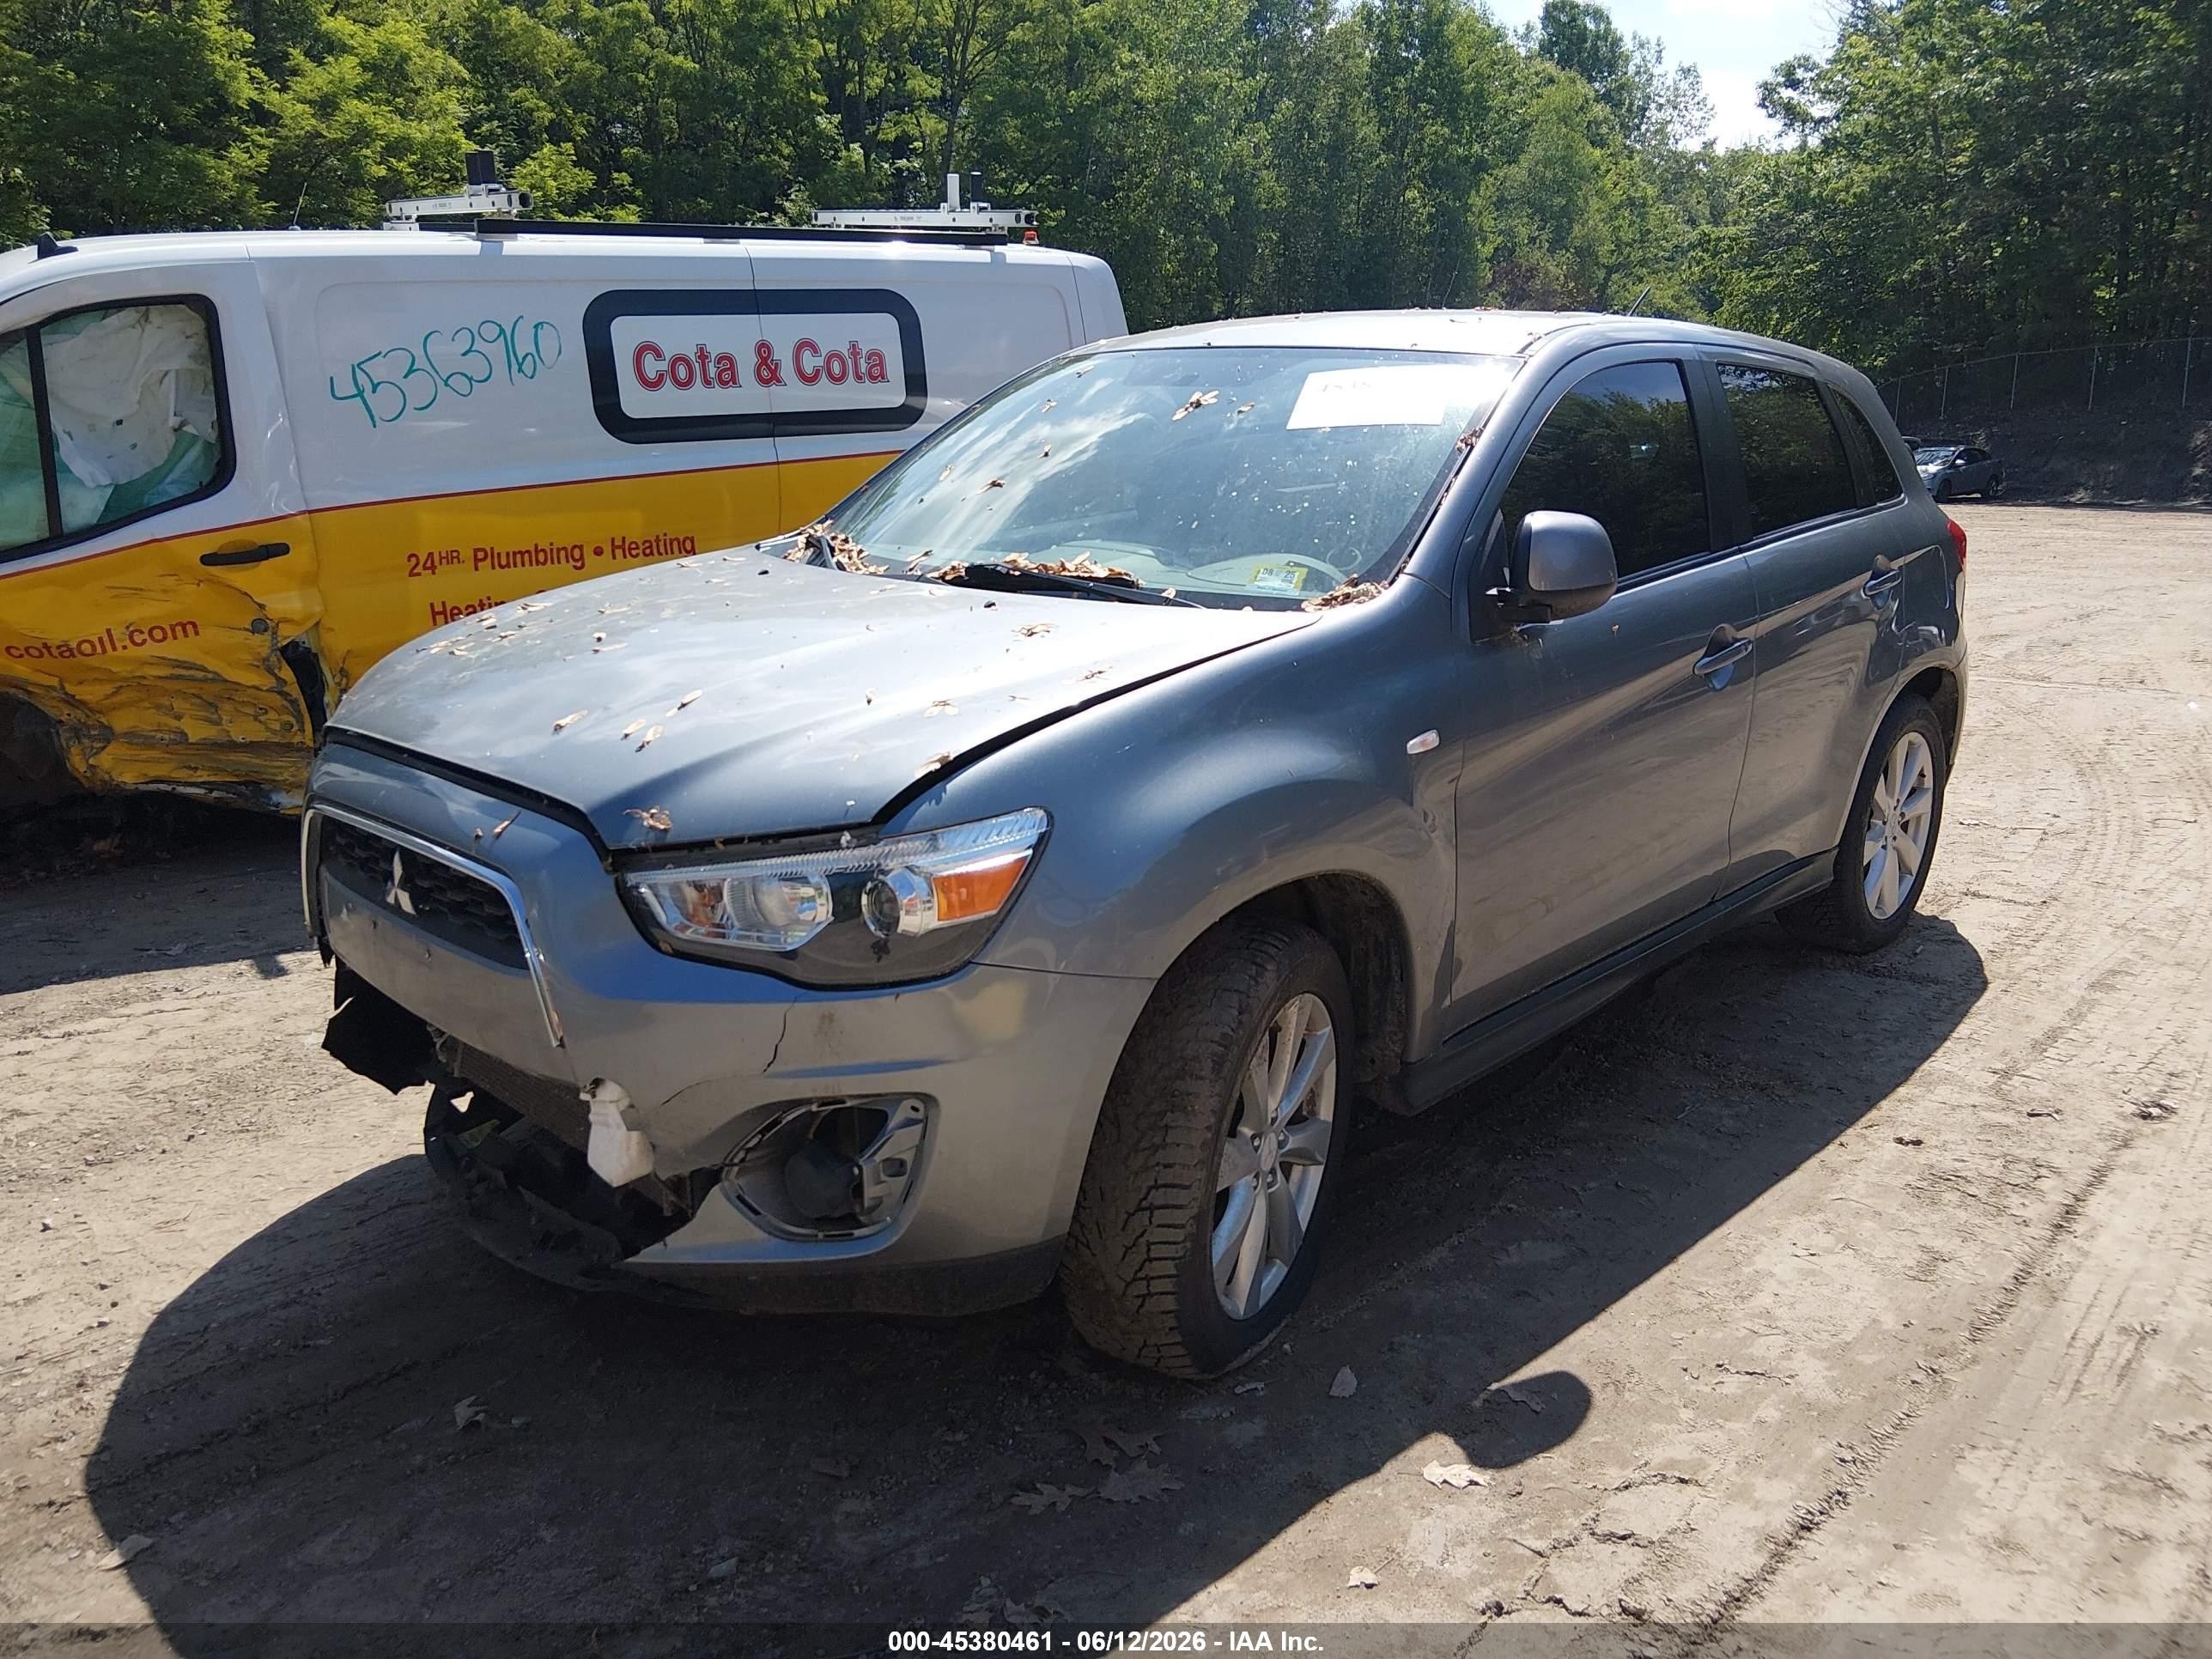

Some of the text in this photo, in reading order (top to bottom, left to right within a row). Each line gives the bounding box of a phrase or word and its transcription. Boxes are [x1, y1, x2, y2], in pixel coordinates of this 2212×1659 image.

[330, 315, 562, 428] 45363960
[633, 337, 890, 392] Cota & Cota
[472, 542, 586, 571] Plumbing
[611, 532, 696, 561] Heating
[429, 595, 507, 626] Heati
[4, 619, 200, 659] cotaoil.com
